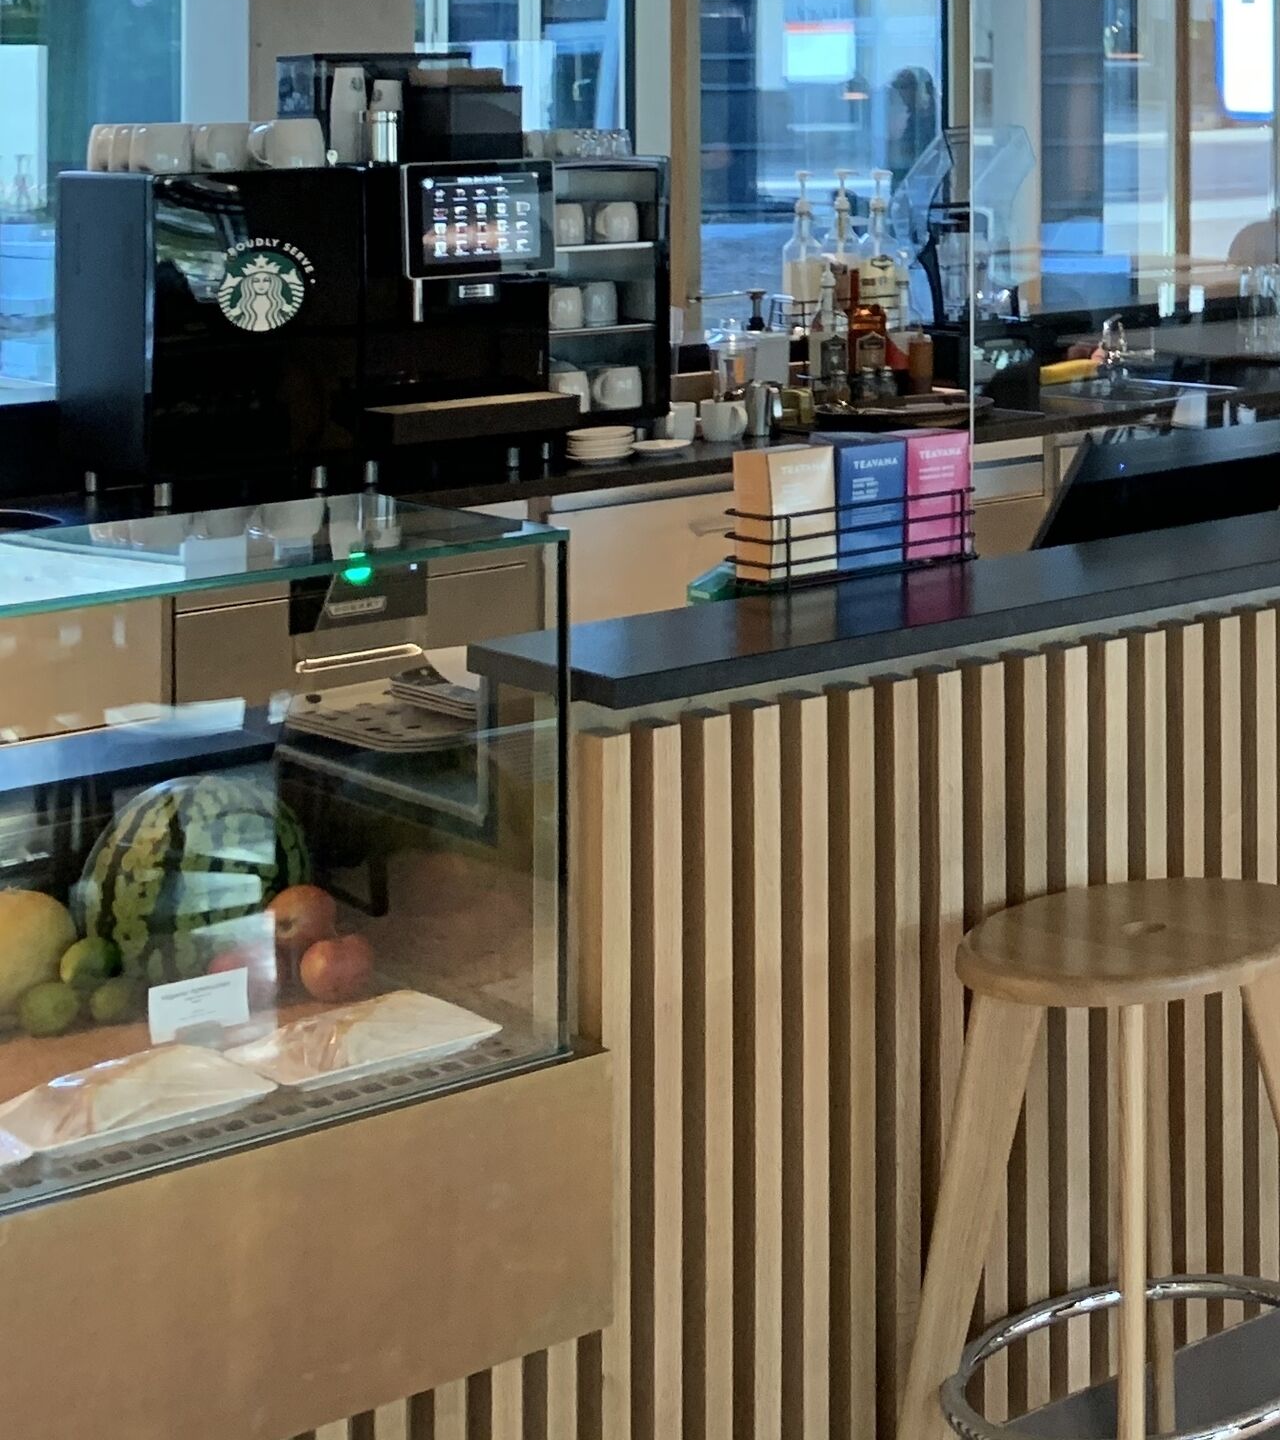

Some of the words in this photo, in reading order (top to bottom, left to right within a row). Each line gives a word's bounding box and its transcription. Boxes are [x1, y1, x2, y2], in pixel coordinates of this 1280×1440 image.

[282, 242, 315, 274] SERVE
[920, 447, 963, 460] TEAVANA
[853, 457, 899, 470] TEAVANA
